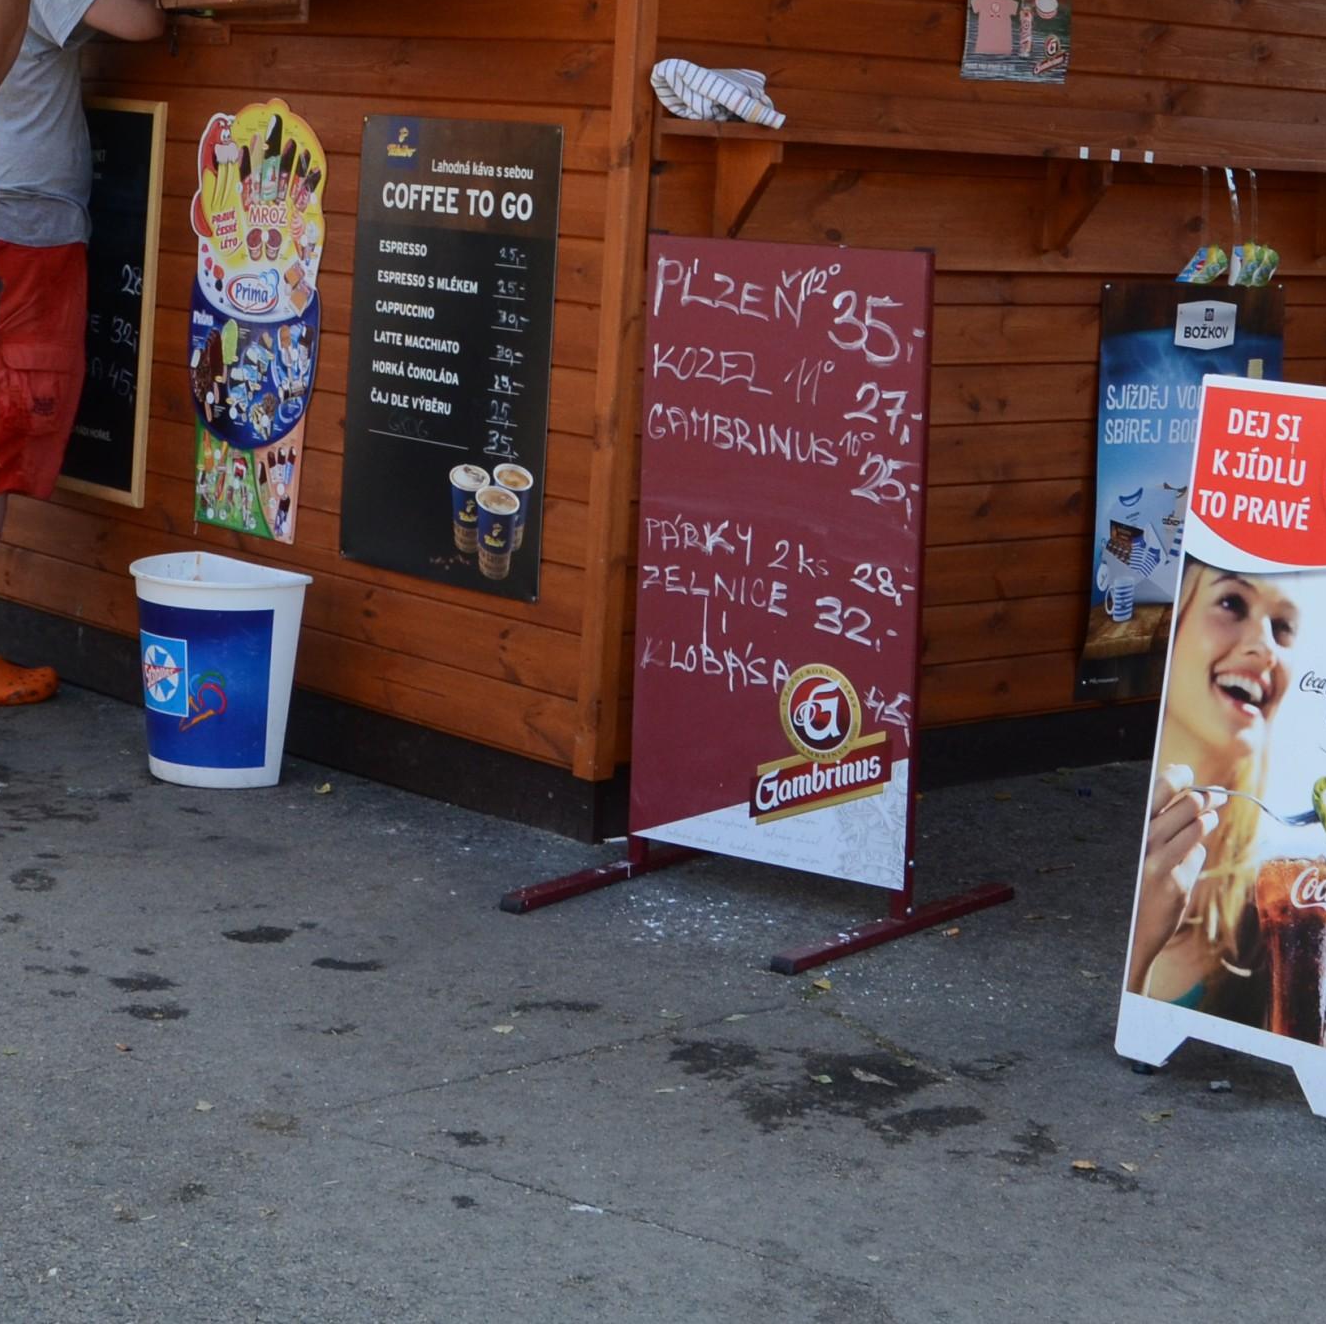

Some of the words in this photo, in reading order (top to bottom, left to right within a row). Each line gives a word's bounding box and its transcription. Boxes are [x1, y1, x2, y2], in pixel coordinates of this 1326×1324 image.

[431, 159, 471, 176] Lahodná
[472, 161, 494, 177] káva
[496, 168, 503, 178] s
[503, 165, 534, 180] sebou
[382, 181, 460, 215] COFFEE
[466, 188, 495, 218] TO
[500, 191, 534, 221] GO
[220, 237, 238, 250] LÉTO
[379, 239, 428, 257] ESPRESSO
[235, 282, 269, 304] Prima
[377, 269, 426, 288] ESPRESSO
[427, 276, 435, 289] S
[436, 276, 479, 295] MLÉKEM
[375, 299, 435, 320] CAPPUCCINO
[373, 329, 403, 346] LATTE
[404, 334, 460, 355] MACCHIATO
[827, 289, 926, 370] 35,-
[1183, 323, 1229, 340] BOŽKOV
[371, 359, 405, 377] HORKÁ
[407, 362, 460, 386] ČOKOLÁDA
[653, 343, 773, 395] KOZEL
[370, 387, 389, 404] ČAJ
[390, 392, 409, 409] DLE
[411, 395, 452, 416] VÝBĚRU
[1106, 384, 1169, 411] SJÍŽDĚJ
[648, 403, 839, 467] GAMBRINUS
[1104, 418, 1162, 444] SBÍREJ
[1227, 407, 1271, 439] DEJ
[1275, 413, 1303, 443] SI
[1212, 448, 1230, 476] K
[1232, 446, 1307, 488] JÍDLU
[1198, 488, 1228, 518] TO
[1232, 494, 1311, 532] PRAVÉ
[645, 513, 753, 567] PÁRKY
[767, 539, 791, 571] 2
[797, 543, 830, 578] ks
[642, 563, 789, 618] ZELNICE
[812, 595, 899, 653] 32,-
[639, 634, 792, 695] KLOBÁSA
[755, 755, 882, 811] Gambrinus
